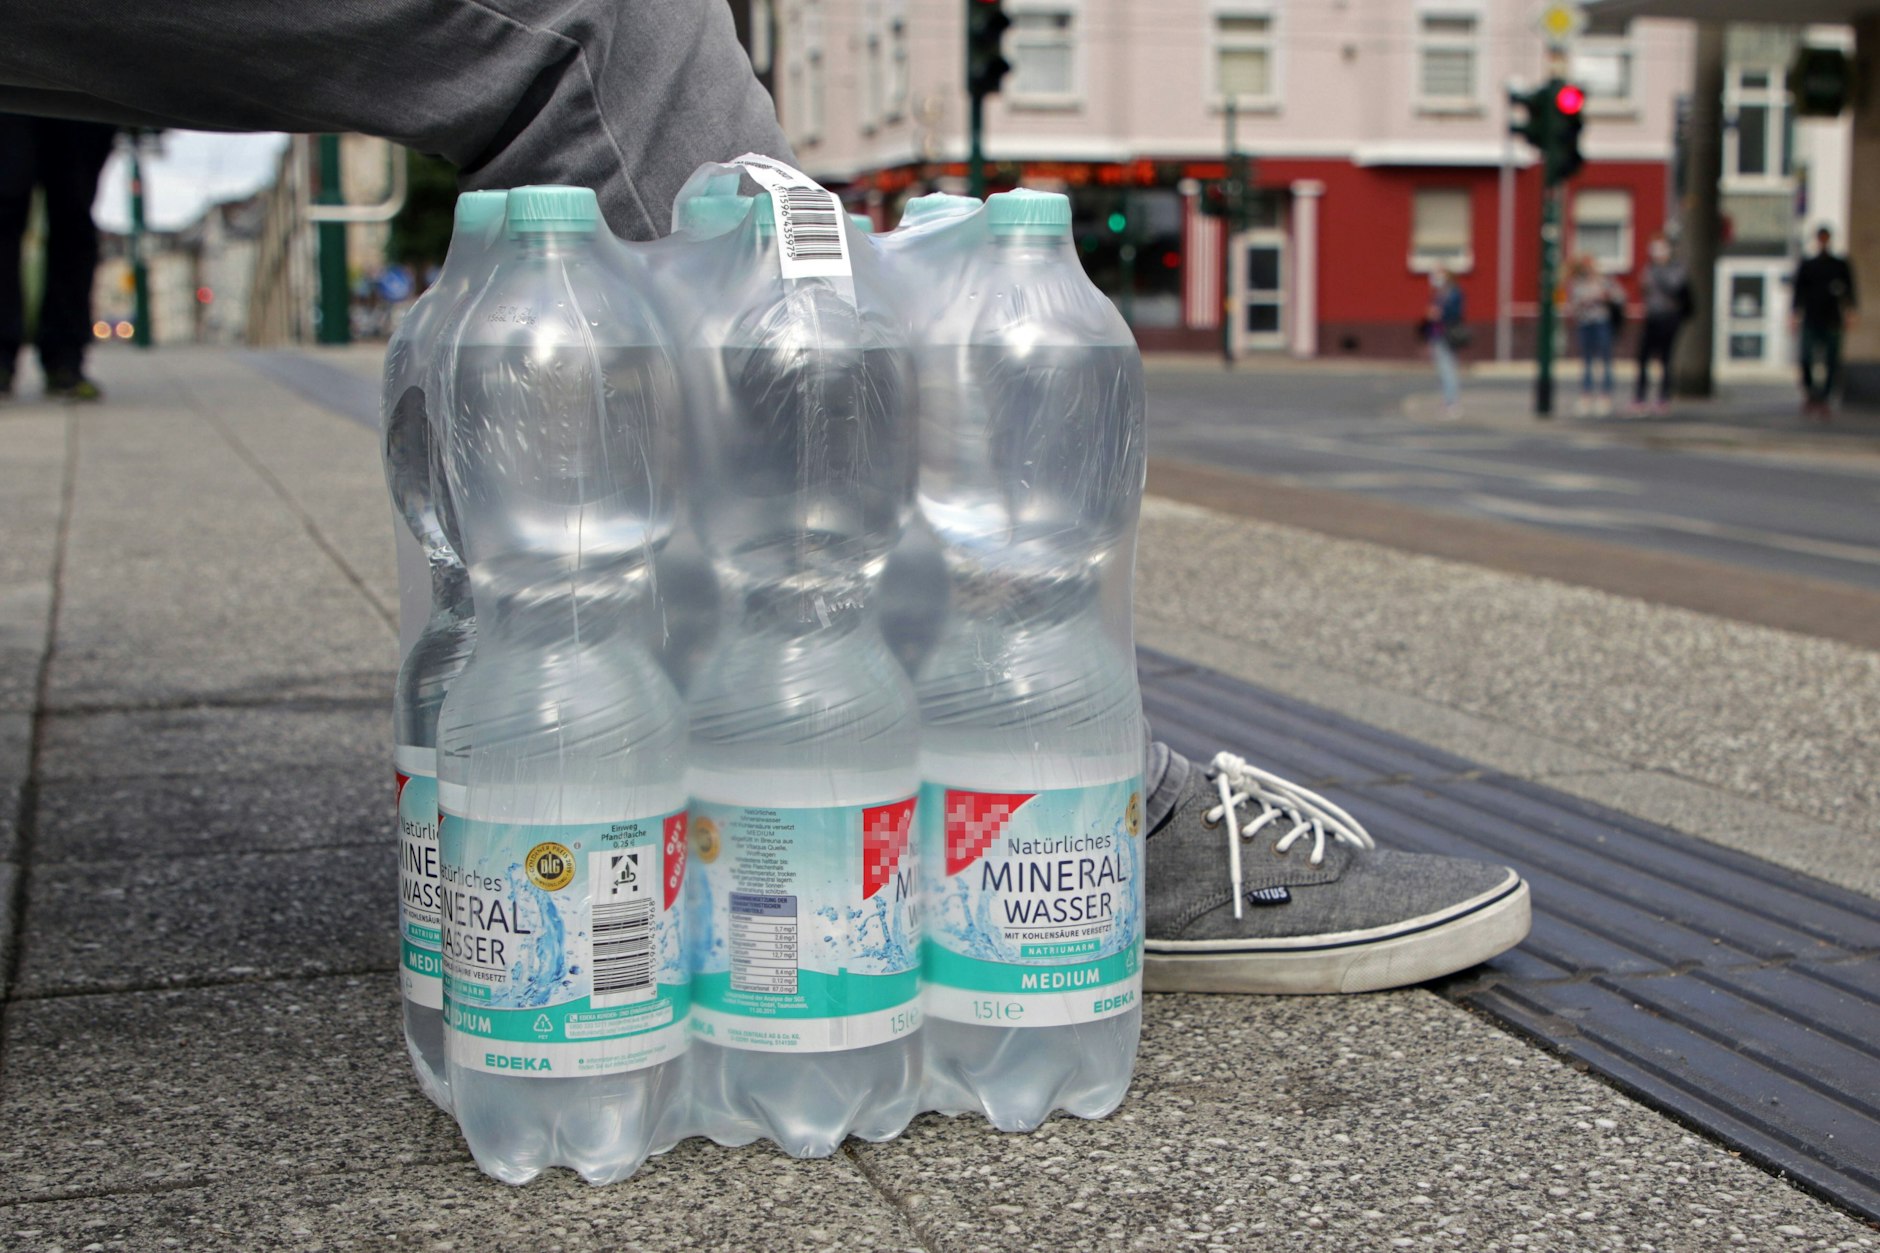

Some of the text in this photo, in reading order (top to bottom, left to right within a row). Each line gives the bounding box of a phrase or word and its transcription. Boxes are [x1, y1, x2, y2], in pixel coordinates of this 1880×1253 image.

[783, 221, 796, 258] 435975
[601, 830, 647, 841] Pfandflasche
[612, 824, 638, 832] Einweg
[1008, 834, 1111, 855] Natürliches
[982, 853, 1127, 893] MINERAL
[1004, 892, 1112, 924] WASSER
[1022, 929, 1079, 940] KOHLENSÄURE
[1081, 924, 1112, 936] VERSETZT
[1028, 943, 1095, 955] NATRIUMARM
[472, 971, 506, 983] VERSETZT
[1021, 968, 1100, 989] MEDIUM
[1093, 990, 1135, 1013] EDEKA
[485, 1053, 553, 1072] EDEKA
